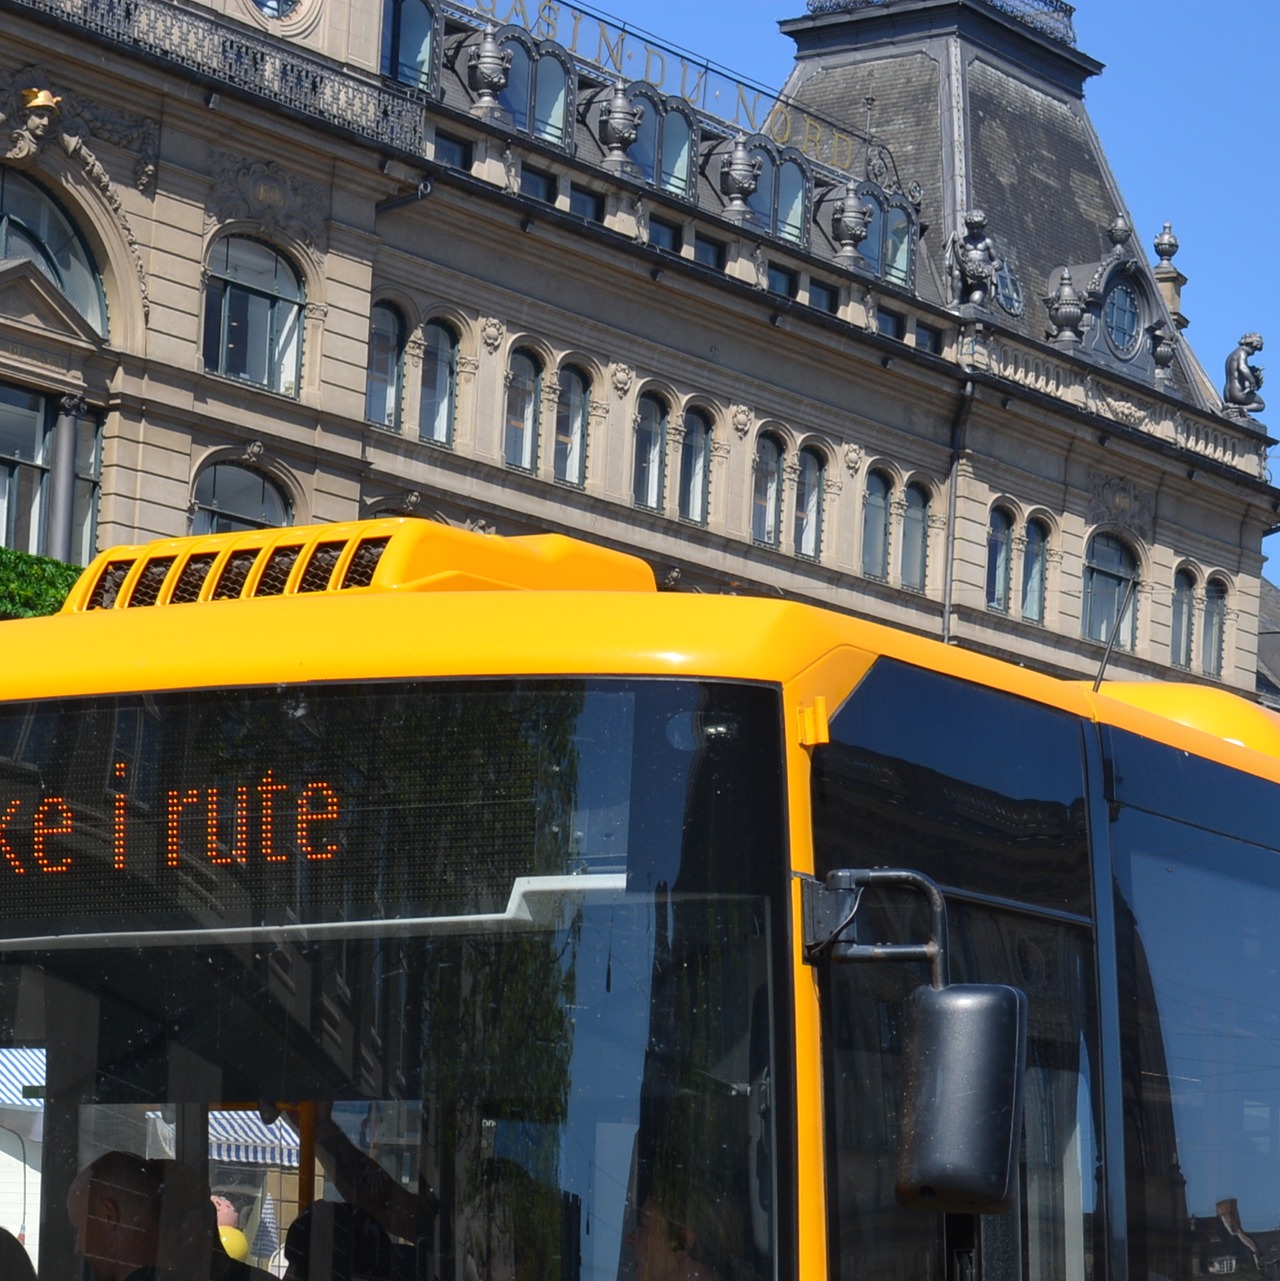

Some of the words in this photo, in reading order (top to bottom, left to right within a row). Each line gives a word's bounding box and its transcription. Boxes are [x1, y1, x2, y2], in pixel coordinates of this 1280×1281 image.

[732, 82, 853, 170] NORD
[113, 762, 126, 869] i
[166, 769, 339, 866] rute
